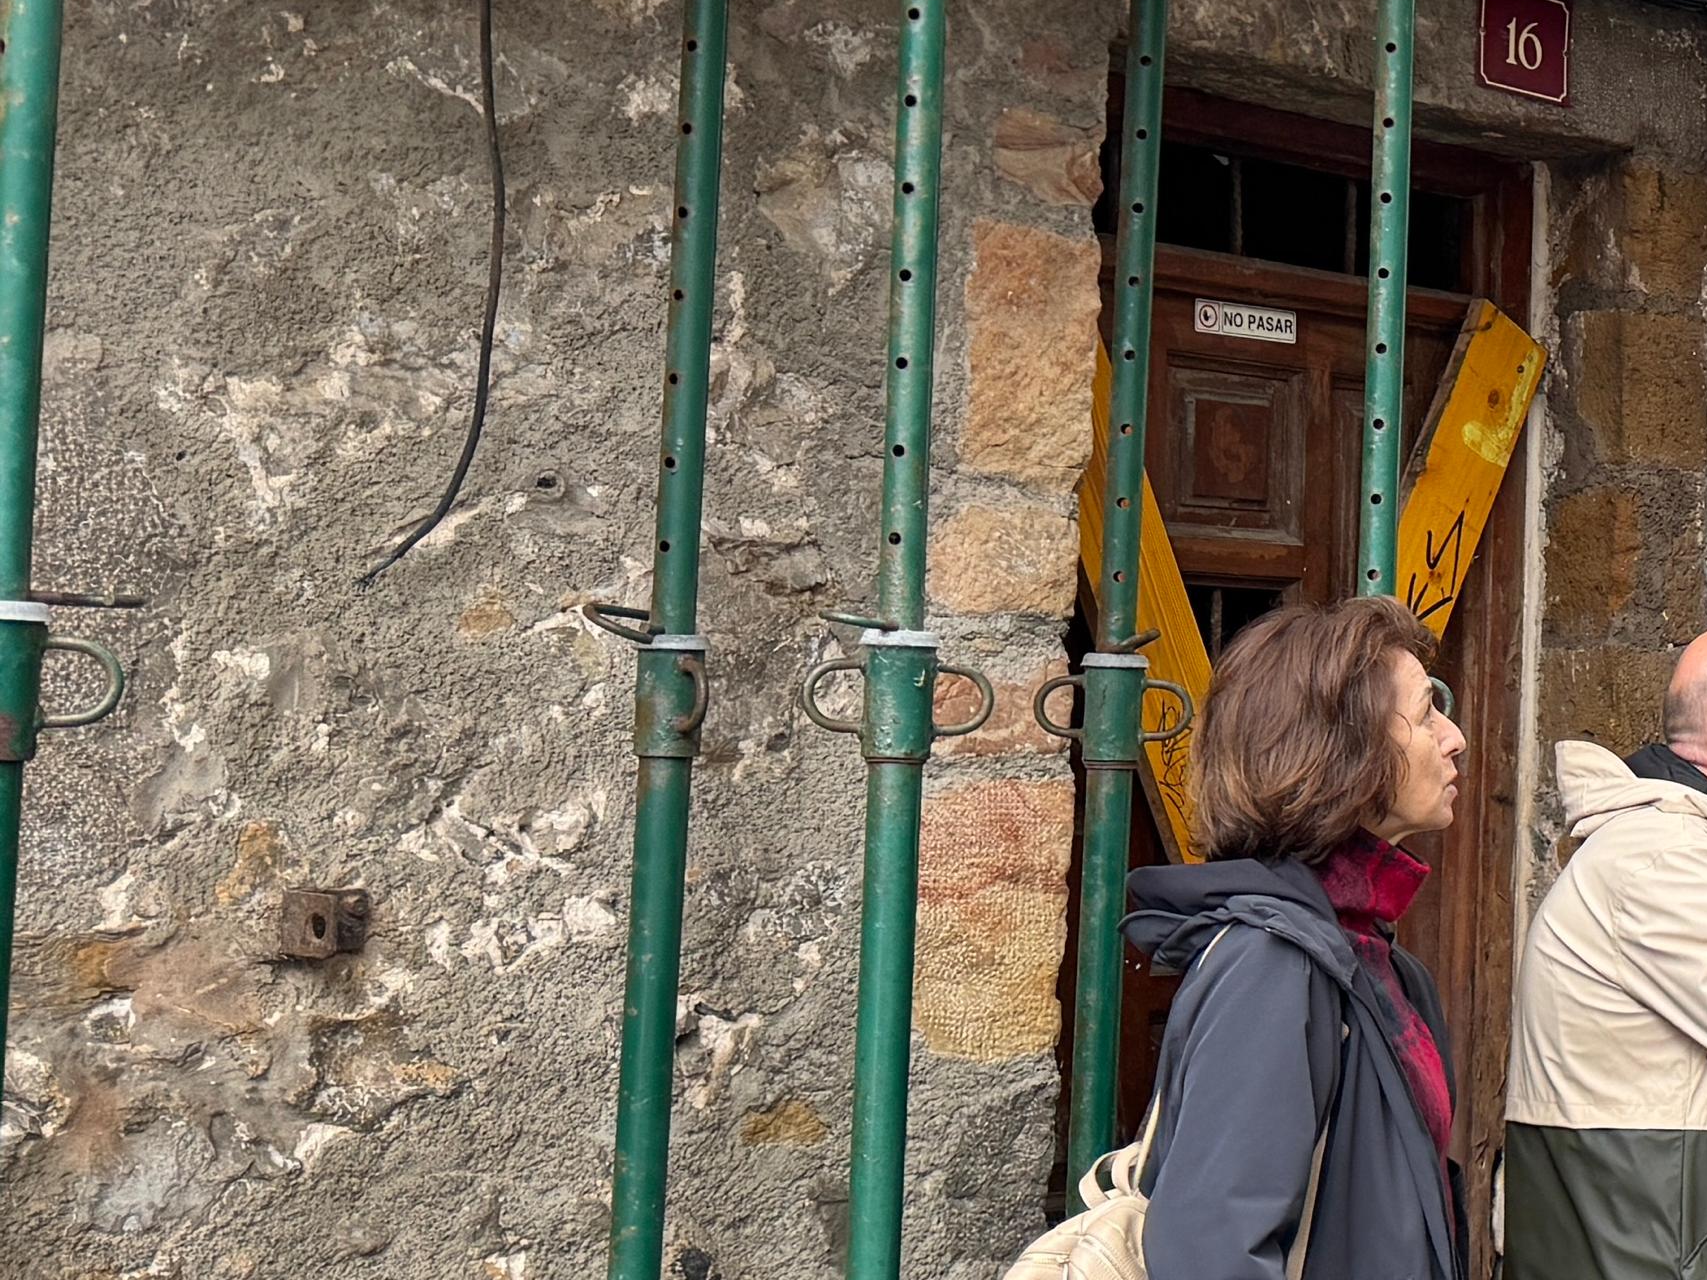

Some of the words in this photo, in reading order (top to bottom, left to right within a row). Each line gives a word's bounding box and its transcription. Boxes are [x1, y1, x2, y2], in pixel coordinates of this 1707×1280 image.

[1505, 17, 1543, 70] 16
[1223, 311, 1244, 328] NO
[1247, 314, 1293, 334] PASAR
